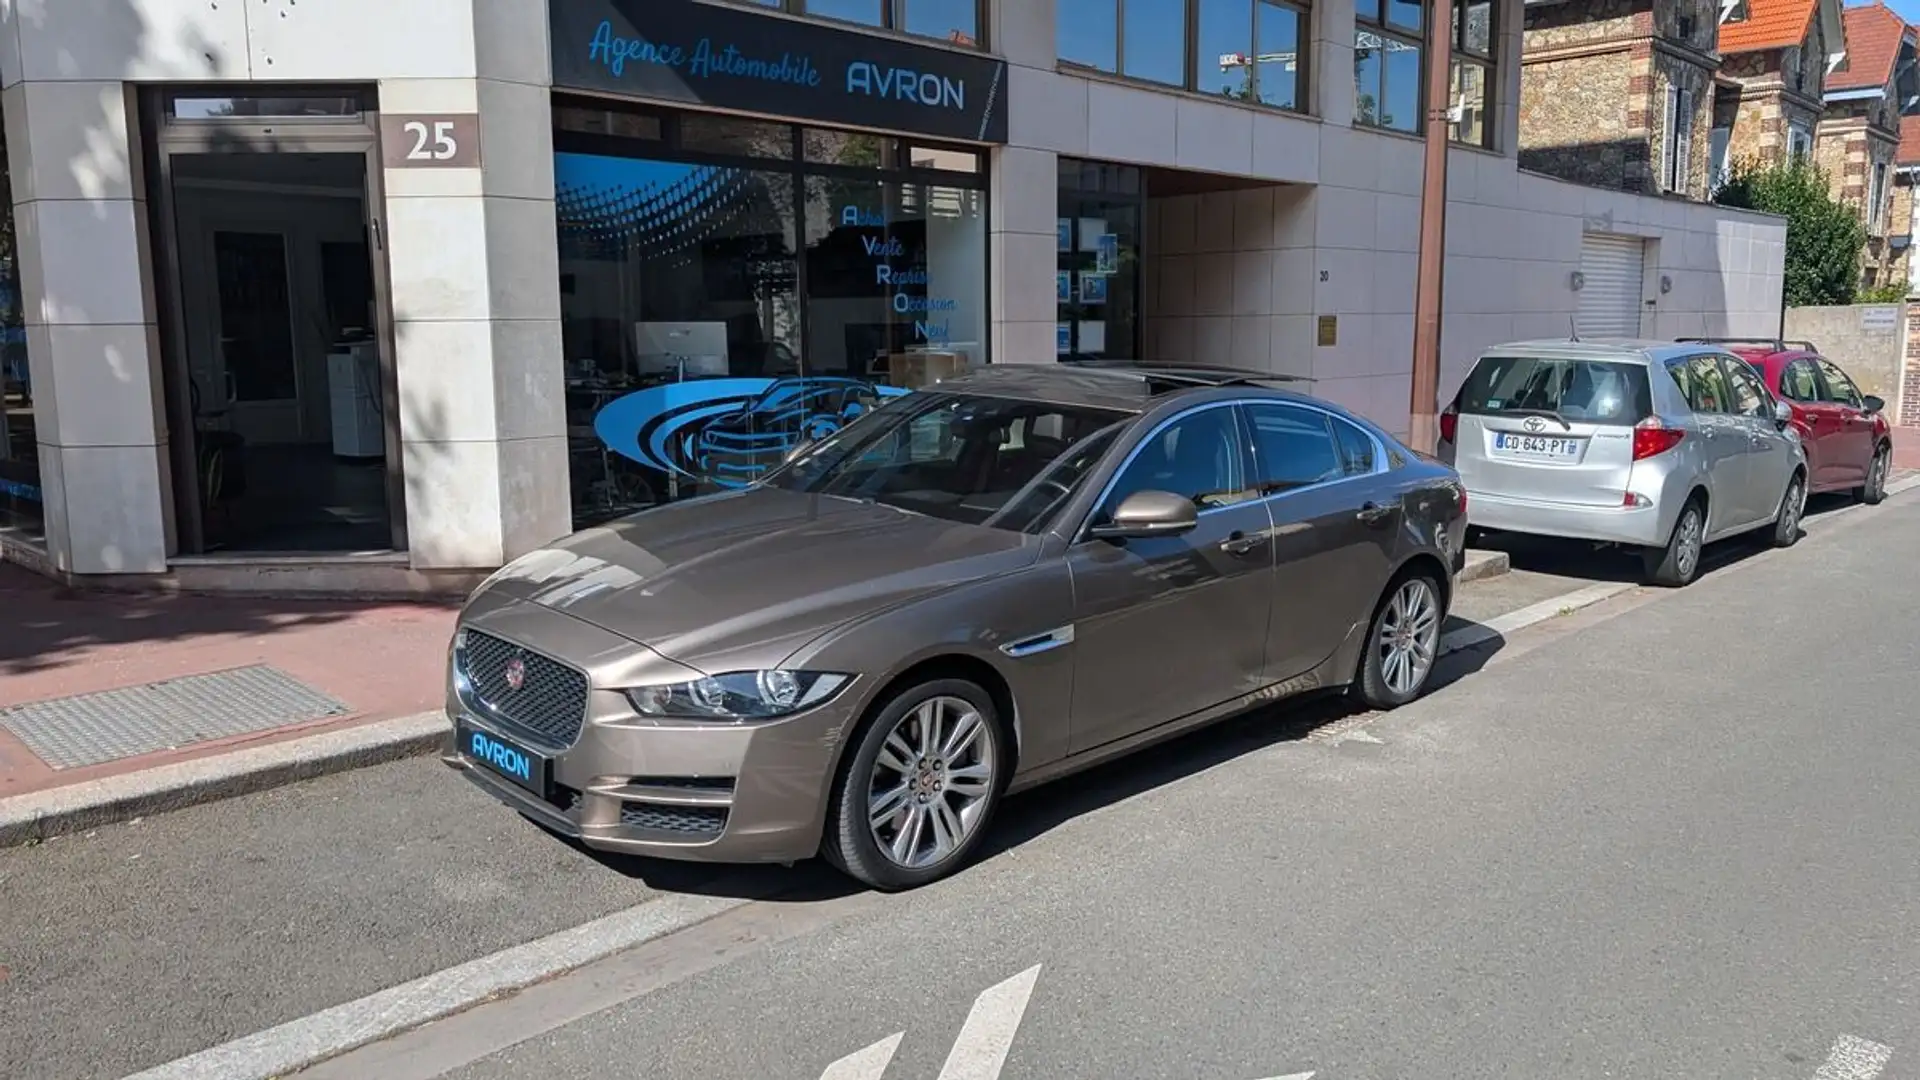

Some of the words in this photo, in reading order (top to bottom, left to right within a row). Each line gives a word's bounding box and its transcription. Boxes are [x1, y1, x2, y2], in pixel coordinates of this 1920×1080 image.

[589, 20, 685, 77] Agence
[691, 38, 821, 87] Automobile
[847, 61, 965, 111] AVRON
[404, 121, 457, 160] 25
[862, 234, 904, 256] Vente
[876, 264, 934, 293] Reprise
[894, 293, 957, 313] Occasion
[914, 318, 950, 348] Neuf
[472, 733, 530, 781] AVRON
